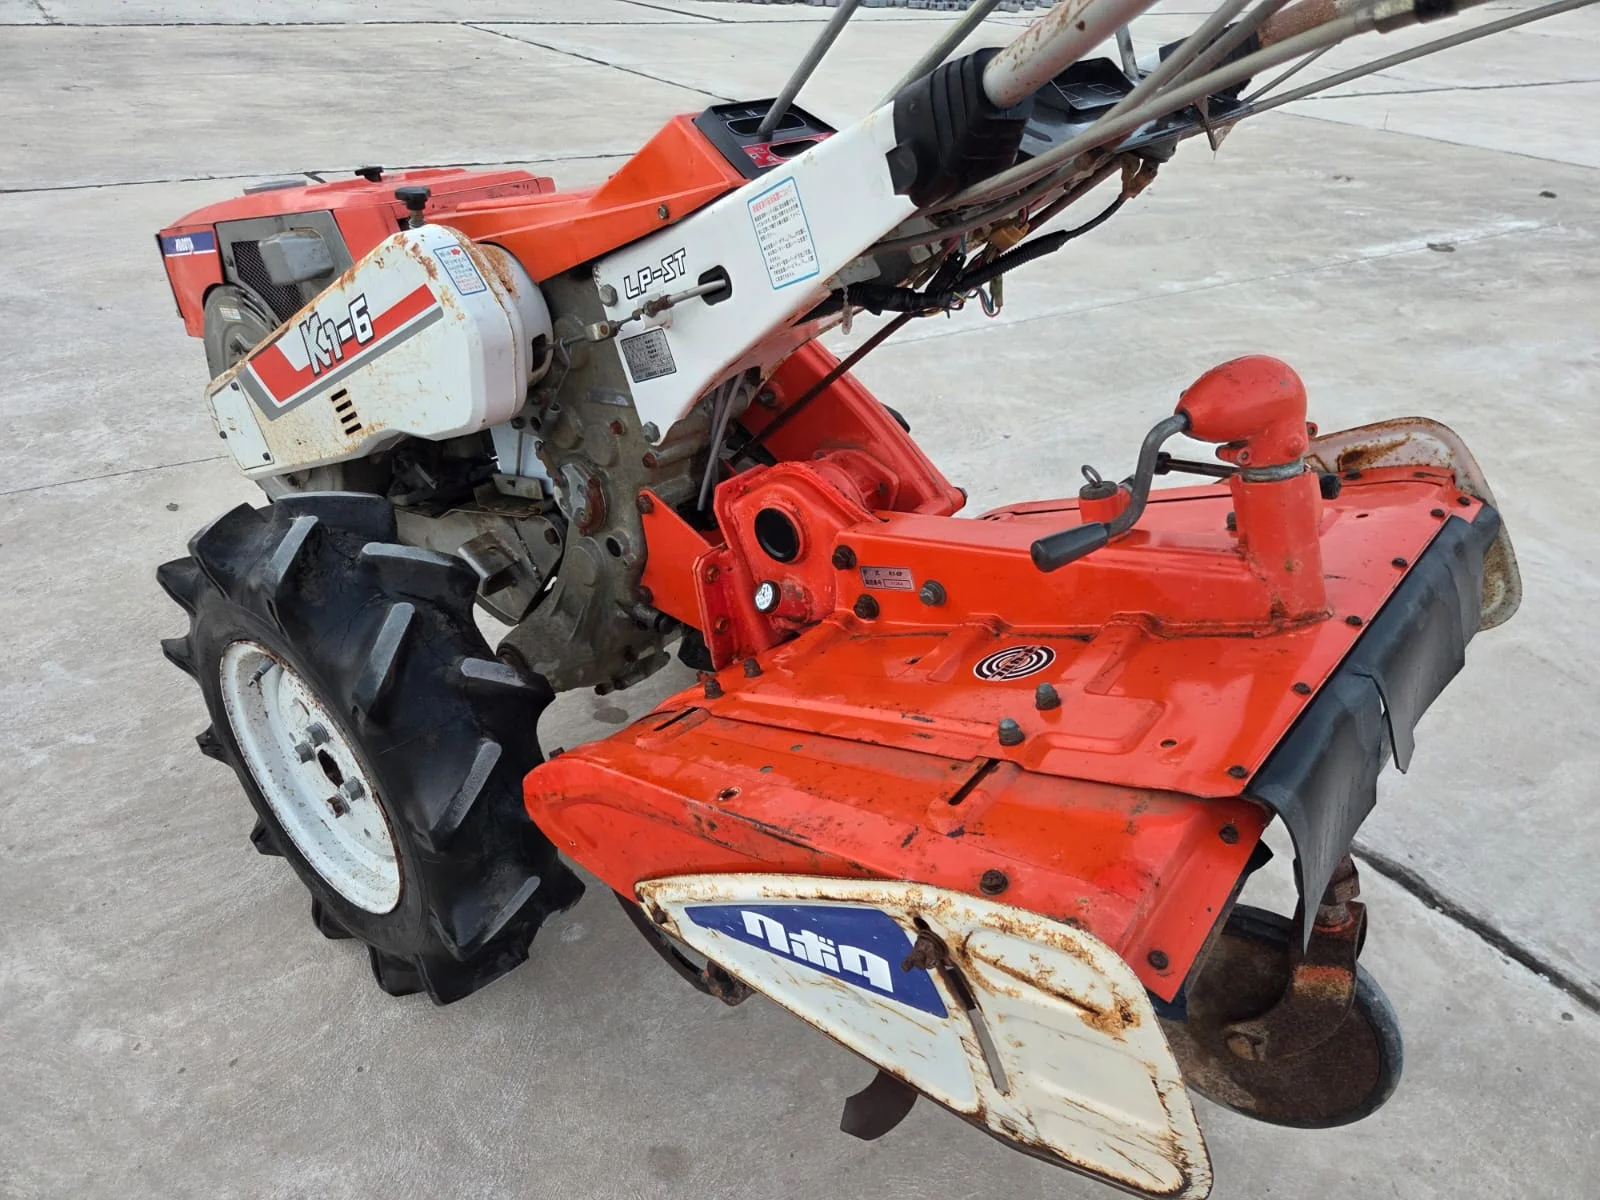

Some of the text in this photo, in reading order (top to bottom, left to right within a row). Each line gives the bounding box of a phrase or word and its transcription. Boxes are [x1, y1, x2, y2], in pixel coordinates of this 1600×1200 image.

[624, 247, 686, 300] LP-ST
[300, 294, 374, 375] K1-6
[741, 911, 893, 992] クボタ
